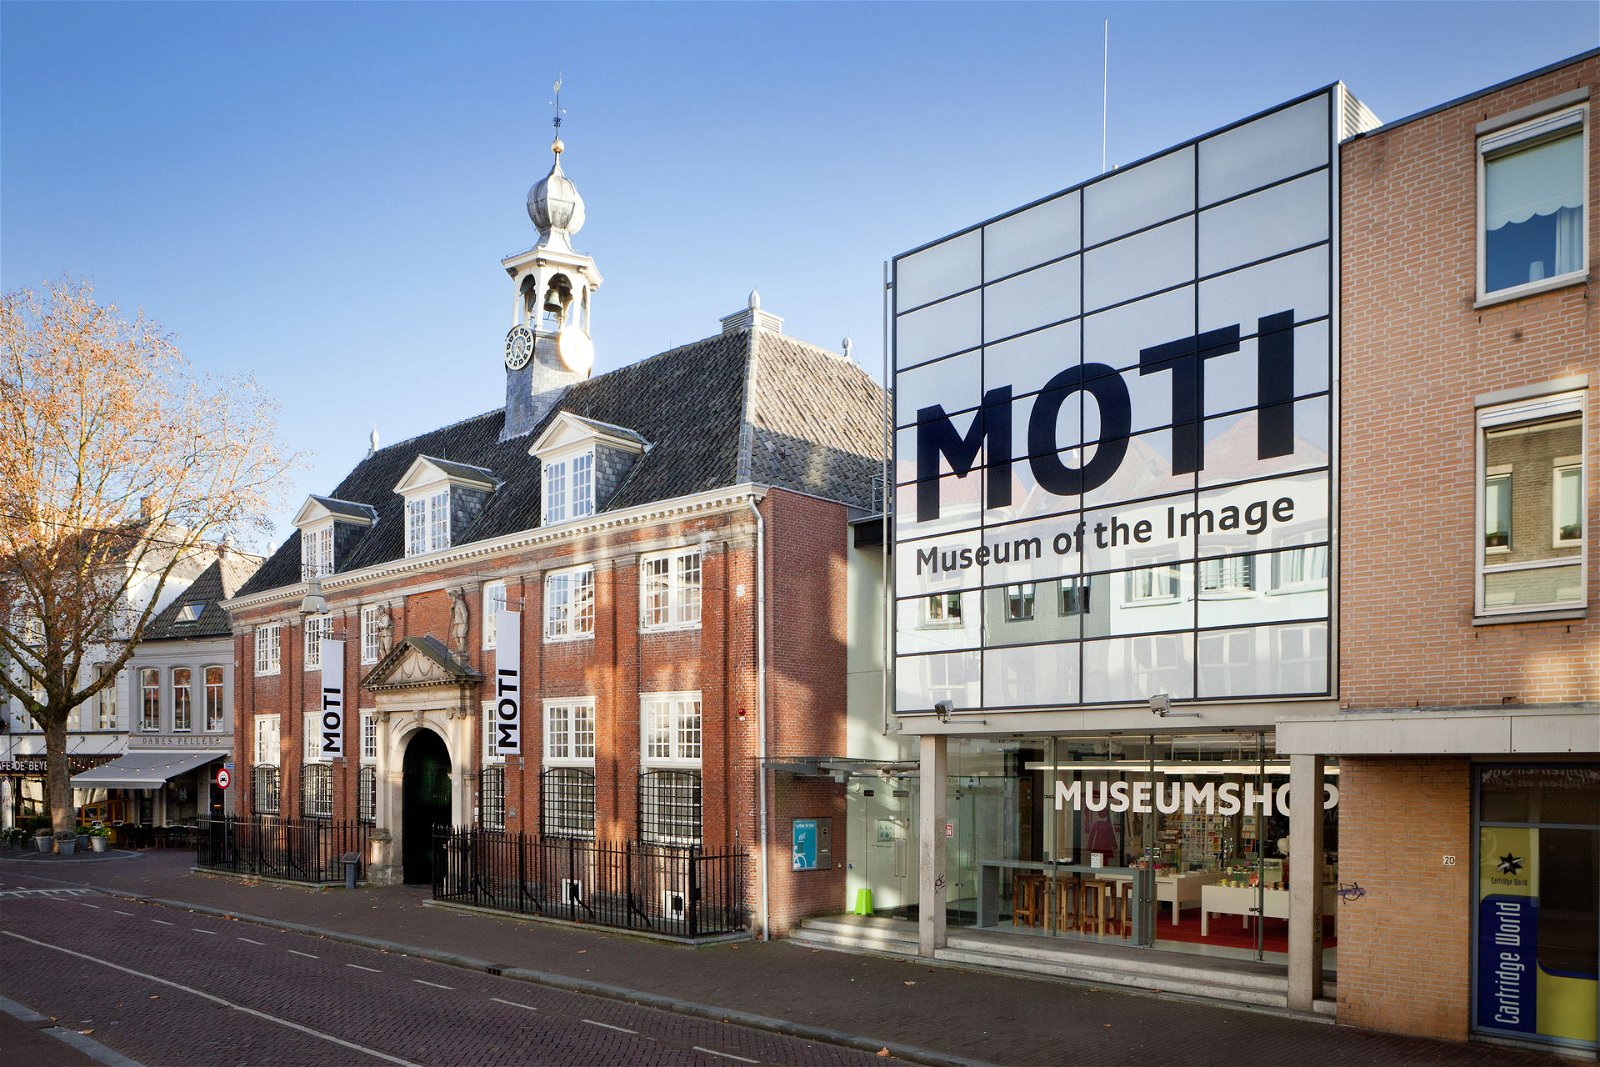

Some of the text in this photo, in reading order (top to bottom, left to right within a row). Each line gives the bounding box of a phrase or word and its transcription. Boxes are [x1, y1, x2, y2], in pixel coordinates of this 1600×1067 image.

[917, 308, 1295, 523] MOTI
[917, 496, 1295, 575] Museum of the Image
[142, 737, 173, 745] DAMES
[323, 687, 341, 752] MOTI
[498, 669, 518, 748] MOTI
[15, 761, 25, 771] DE
[1444, 856, 1455, 865] 20
[1494, 902, 1525, 1024] Cartridge World
